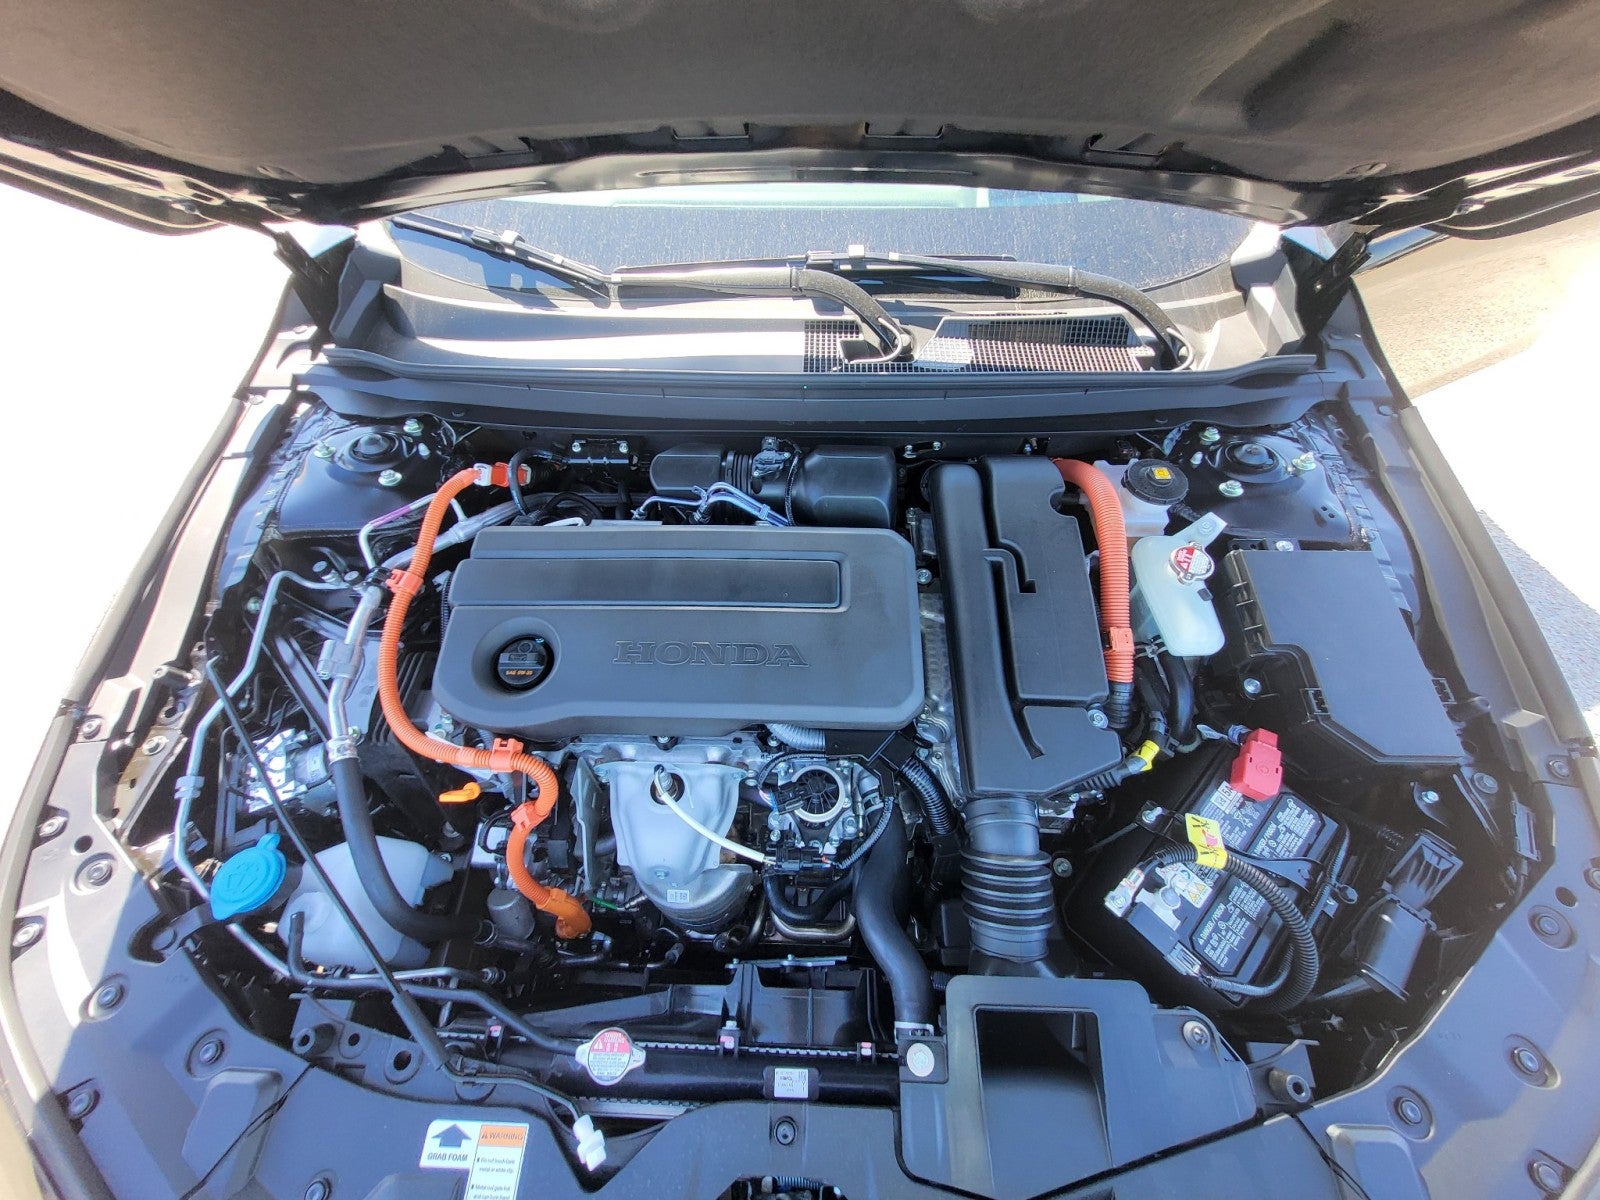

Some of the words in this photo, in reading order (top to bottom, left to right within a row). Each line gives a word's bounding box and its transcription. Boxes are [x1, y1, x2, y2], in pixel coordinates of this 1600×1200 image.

[612, 640, 812, 668] HONDA
[489, 1132, 524, 1141] WARNING
[427, 1152, 447, 1161] GRAB
[447, 1153, 469, 1162] FOAM
